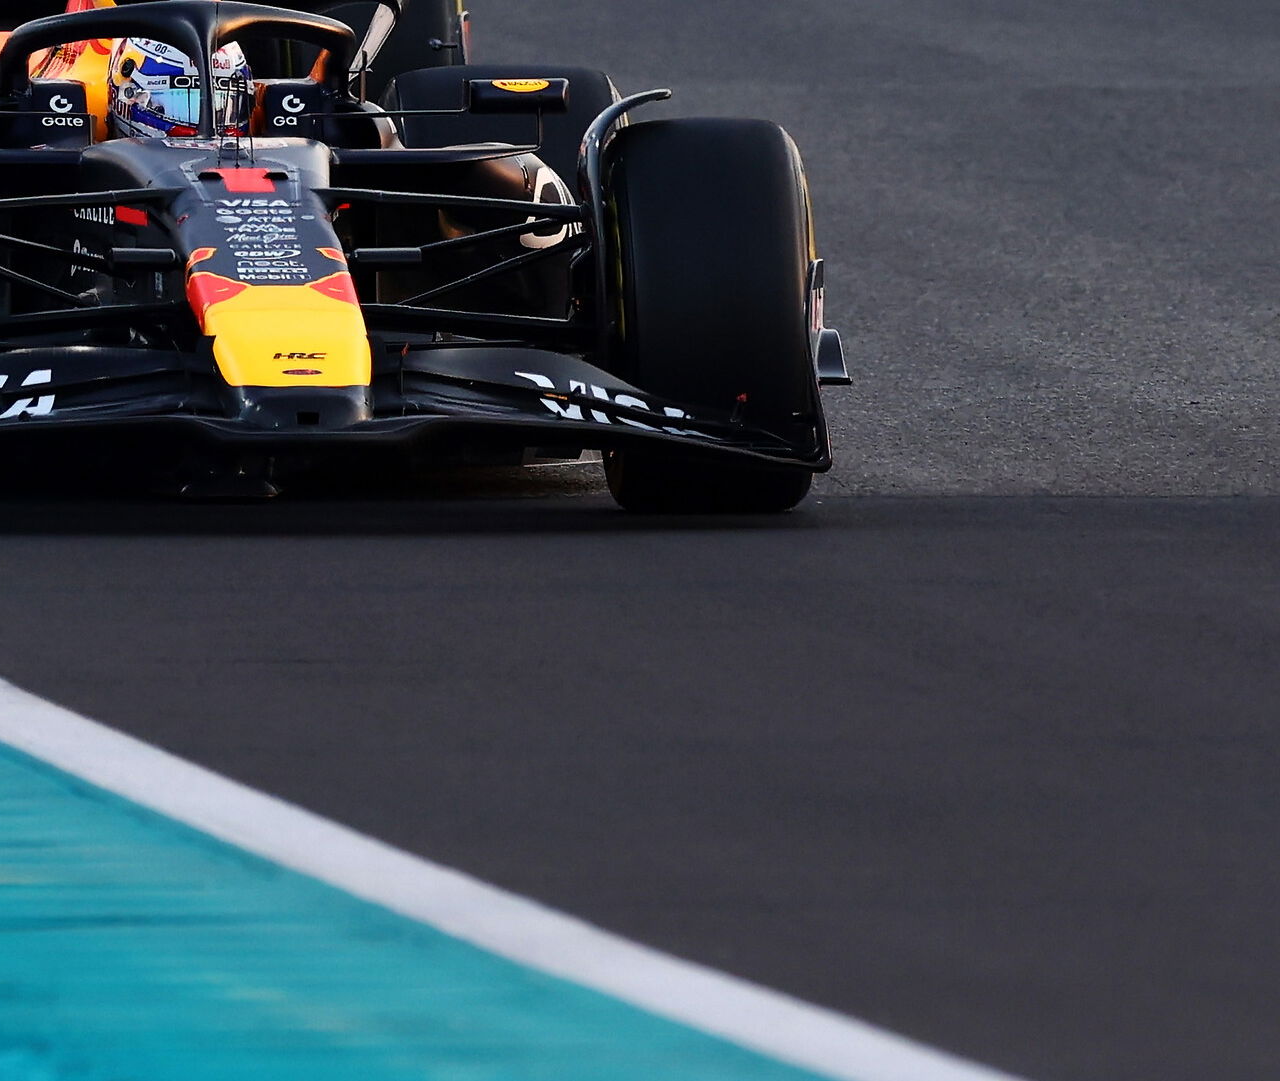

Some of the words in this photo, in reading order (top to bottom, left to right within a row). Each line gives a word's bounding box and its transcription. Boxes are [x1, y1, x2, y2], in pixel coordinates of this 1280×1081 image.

[41, 116, 84, 128] Gate
[217, 199, 290, 208] VISA
[273, 352, 327, 360] HRC
